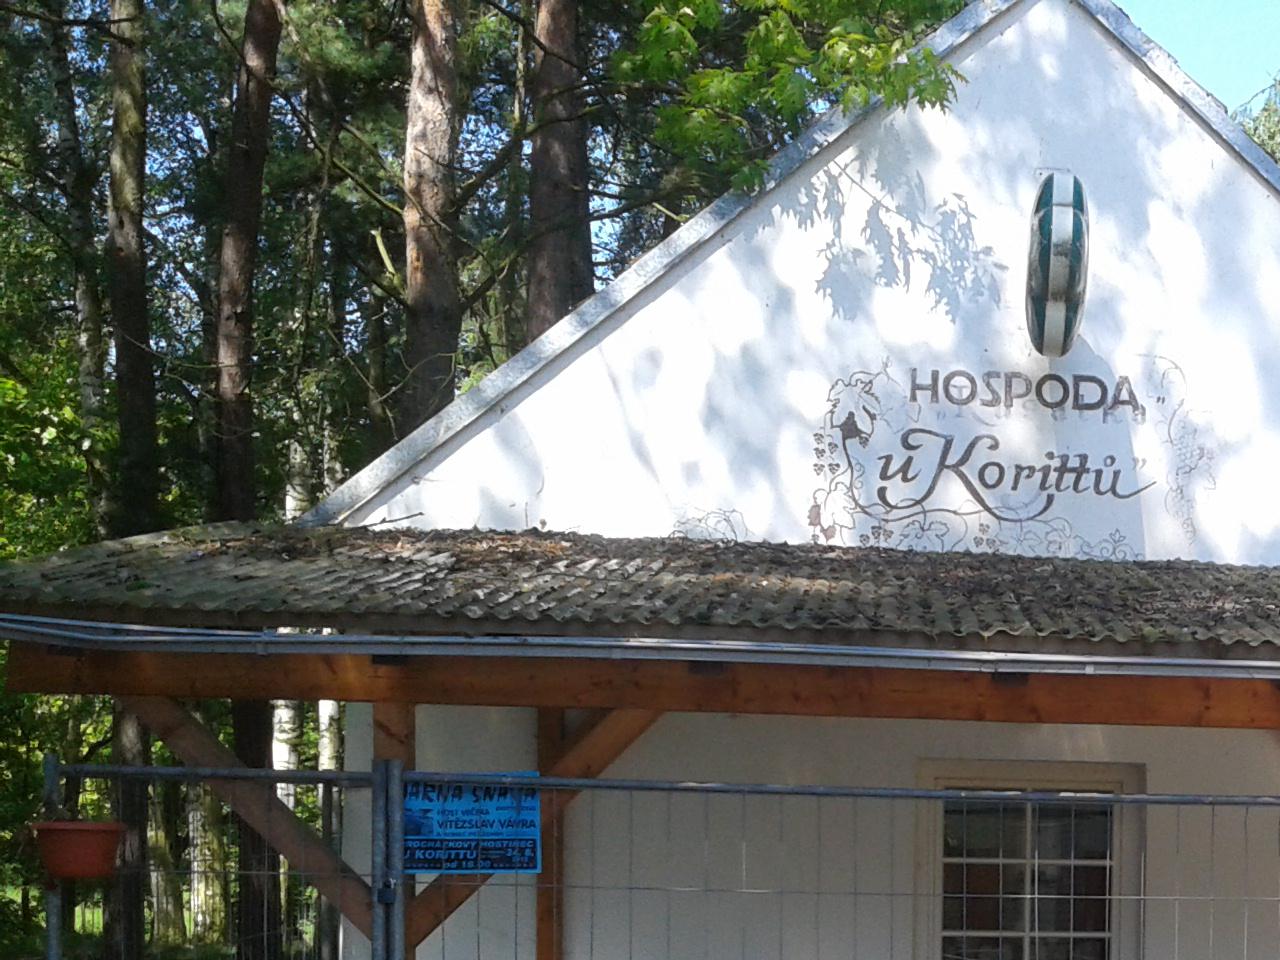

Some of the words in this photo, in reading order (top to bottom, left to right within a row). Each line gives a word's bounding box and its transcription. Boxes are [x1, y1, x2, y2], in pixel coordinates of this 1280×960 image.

[908, 368, 1140, 411] HOSPODA
[877, 450, 922, 483] u
[879, 428, 1157, 521] Korittů
[415, 850, 477, 859] KORITTU
